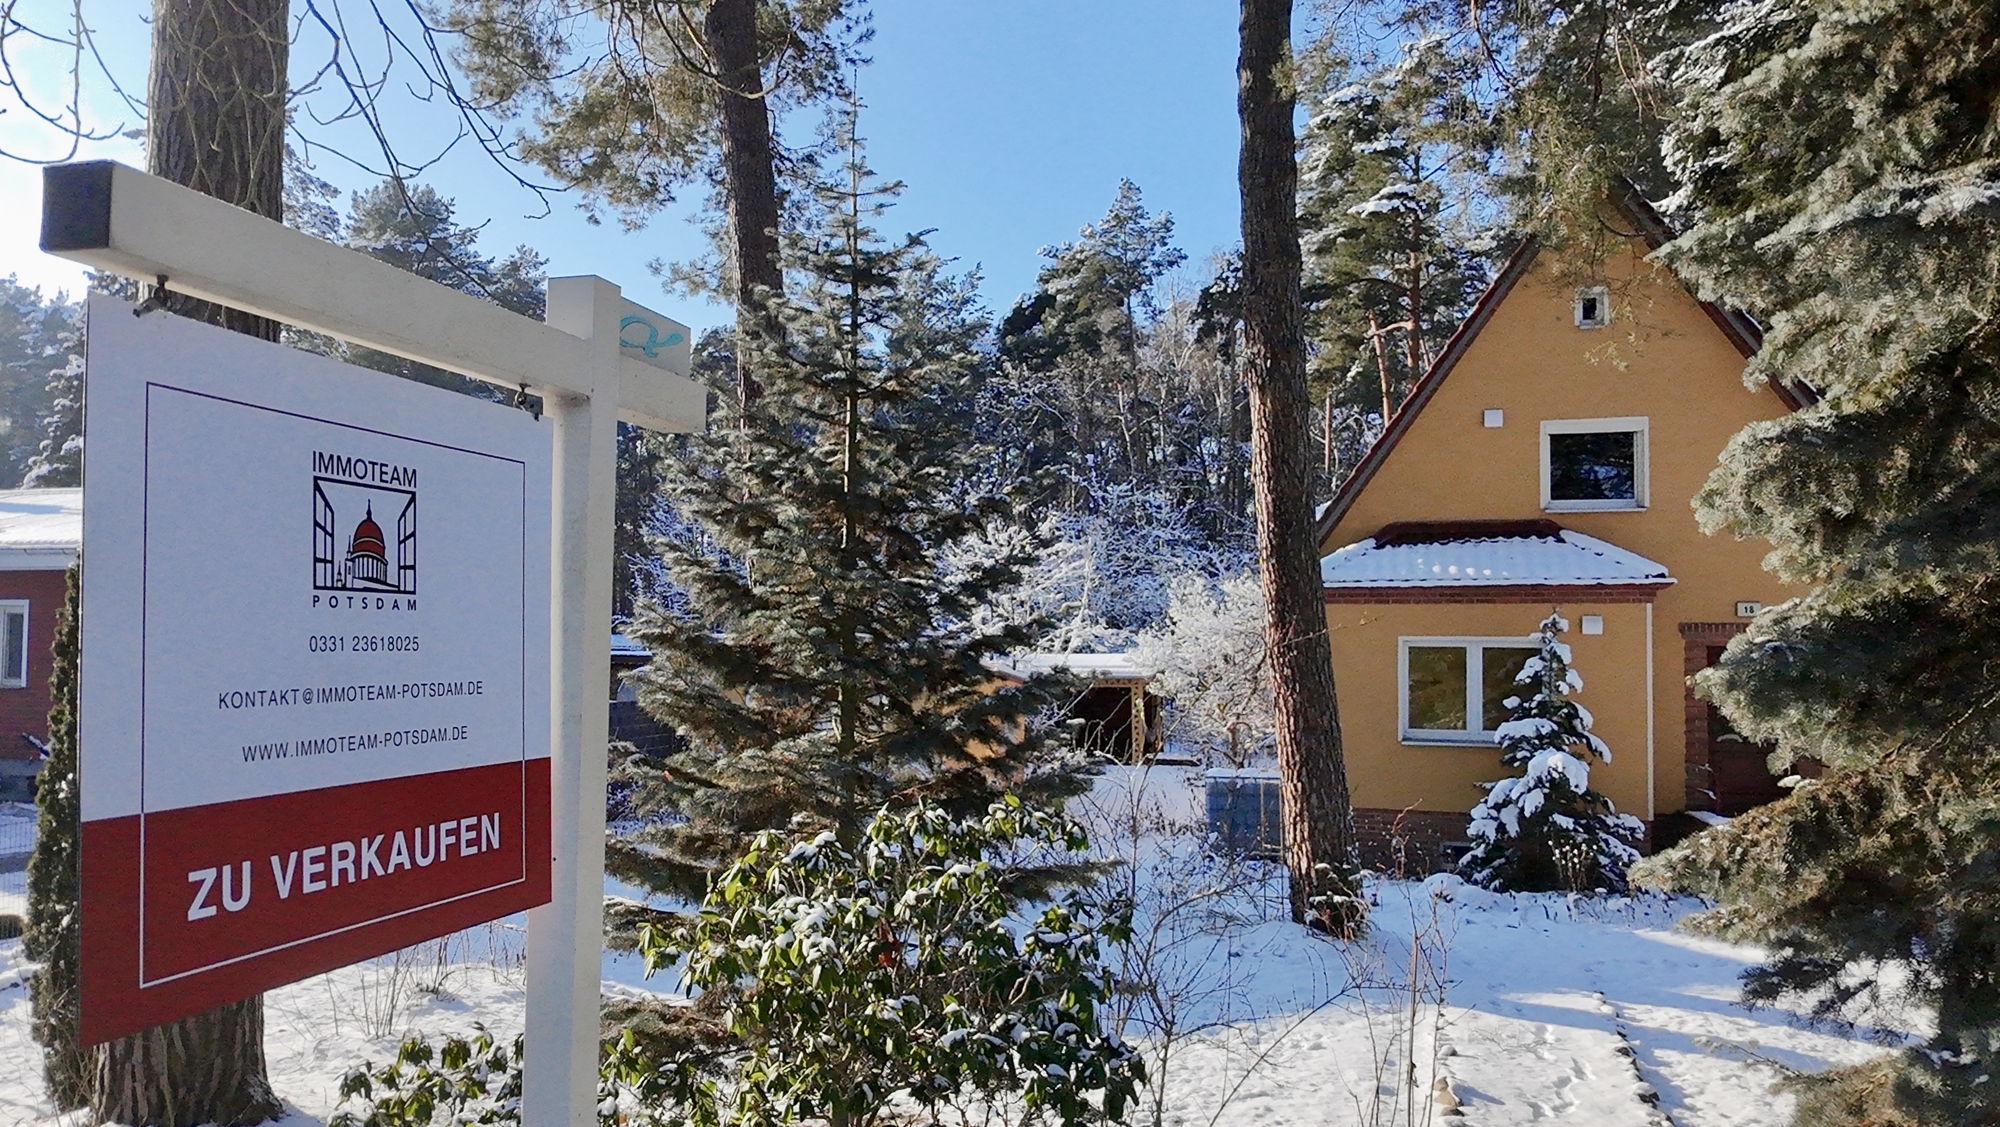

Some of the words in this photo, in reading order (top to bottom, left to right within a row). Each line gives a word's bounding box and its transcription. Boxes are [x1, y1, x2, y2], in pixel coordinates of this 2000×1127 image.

[313, 450, 417, 488] IMMOTEAM
[312, 595, 417, 611] POTSDAM
[1744, 605, 1755, 614] 18
[309, 635, 345, 652] 0331
[352, 635, 420, 652] 23618025
[218, 681, 483, 709] KONTAKT@IMMOTEAM-POTSDAM.DE
[242, 725, 468, 762] WWW.IMMOTEAM-POTSDAM.DE
[187, 861, 251, 921] ZU
[270, 812, 500, 899] VERKAUFEN
